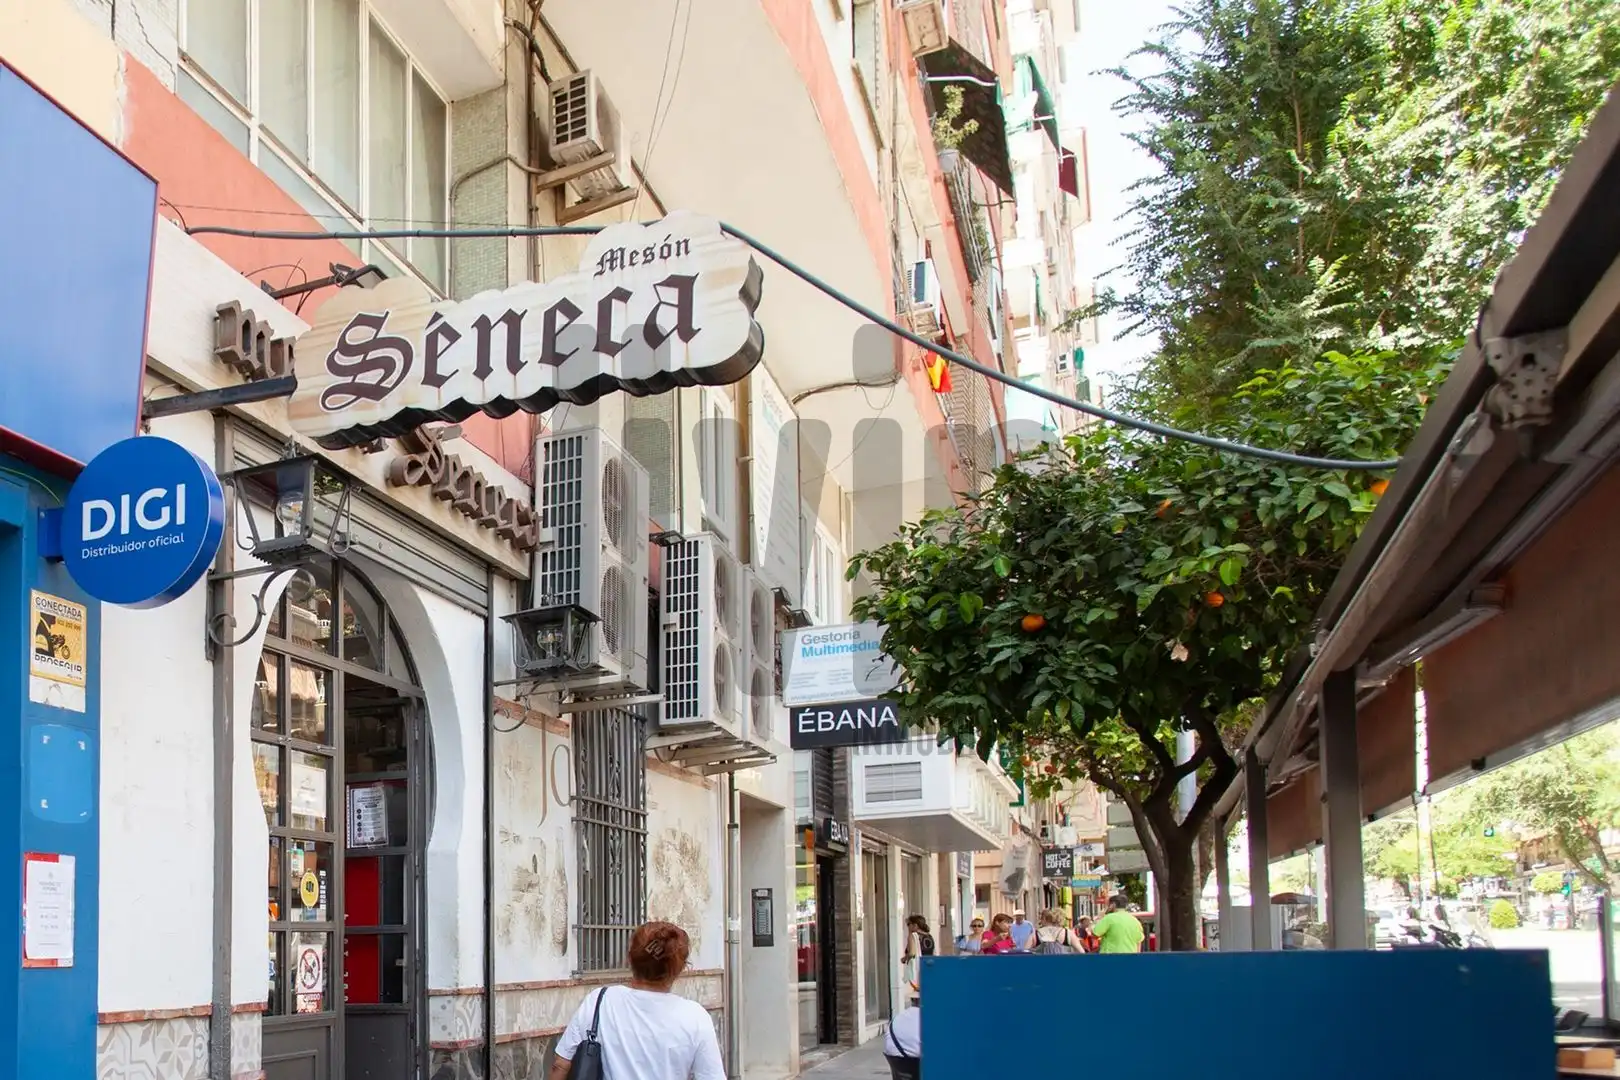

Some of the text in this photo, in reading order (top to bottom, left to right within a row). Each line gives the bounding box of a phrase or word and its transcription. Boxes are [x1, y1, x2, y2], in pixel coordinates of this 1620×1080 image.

[593, 233, 690, 277] Mesón
[323, 271, 702, 411] Séneca
[82, 483, 186, 541] DIGI
[82, 533, 185, 559] Distribuidor oficial
[35, 597, 82, 618] CONECTADA
[801, 640, 880, 658] Multimedia
[798, 706, 898, 733] ÉBANA
[1045, 859, 1071, 869] COFFEE
